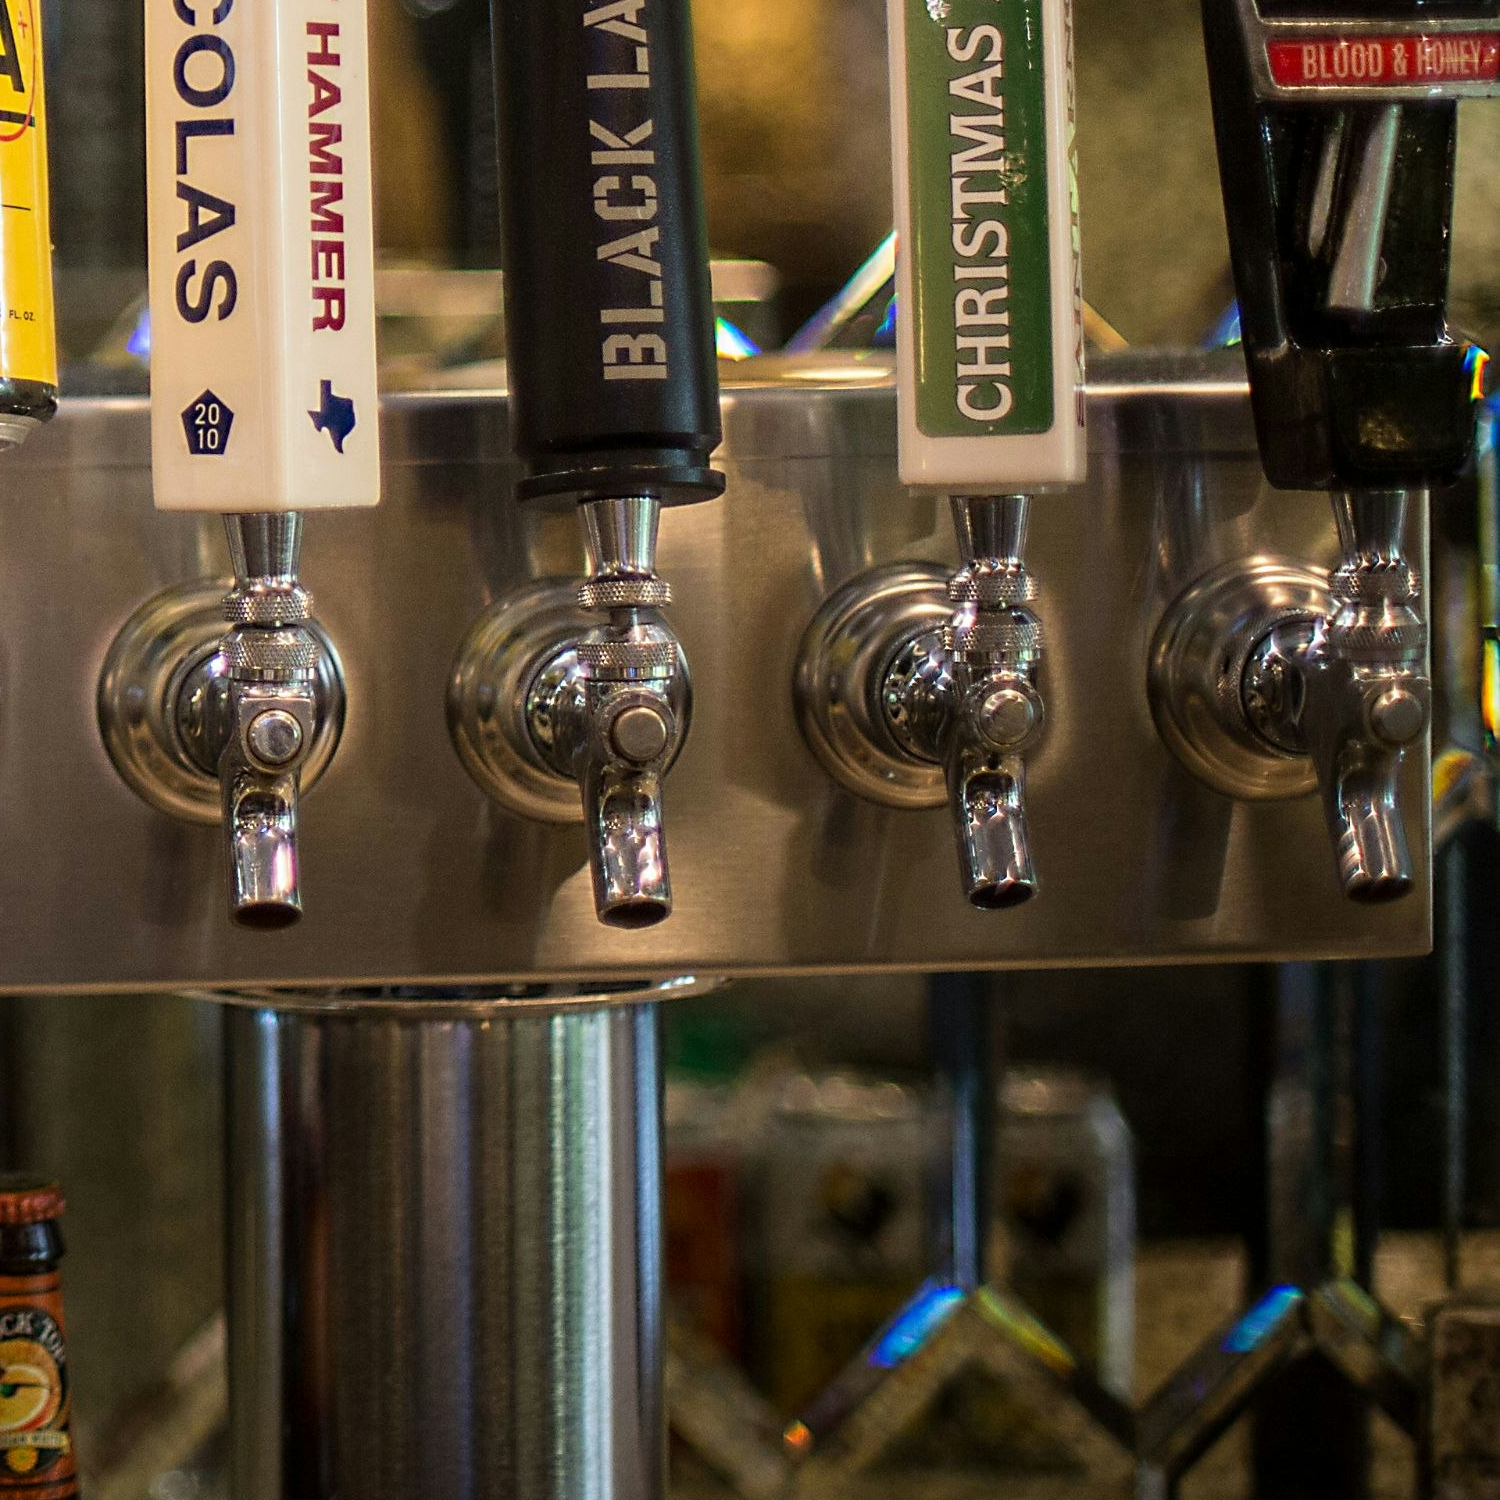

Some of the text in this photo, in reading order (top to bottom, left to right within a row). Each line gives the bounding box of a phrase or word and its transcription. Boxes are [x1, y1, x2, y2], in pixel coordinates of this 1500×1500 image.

[1302, 38, 1483, 80] BLOOD & HONEY
[304, 21, 348, 334] HAMMER
[588, 118, 668, 380] BLACK
[944, 23, 1014, 422] CHRISTMAS
[194, 402, 220, 427] 20
[197, 426, 220, 451] 10
